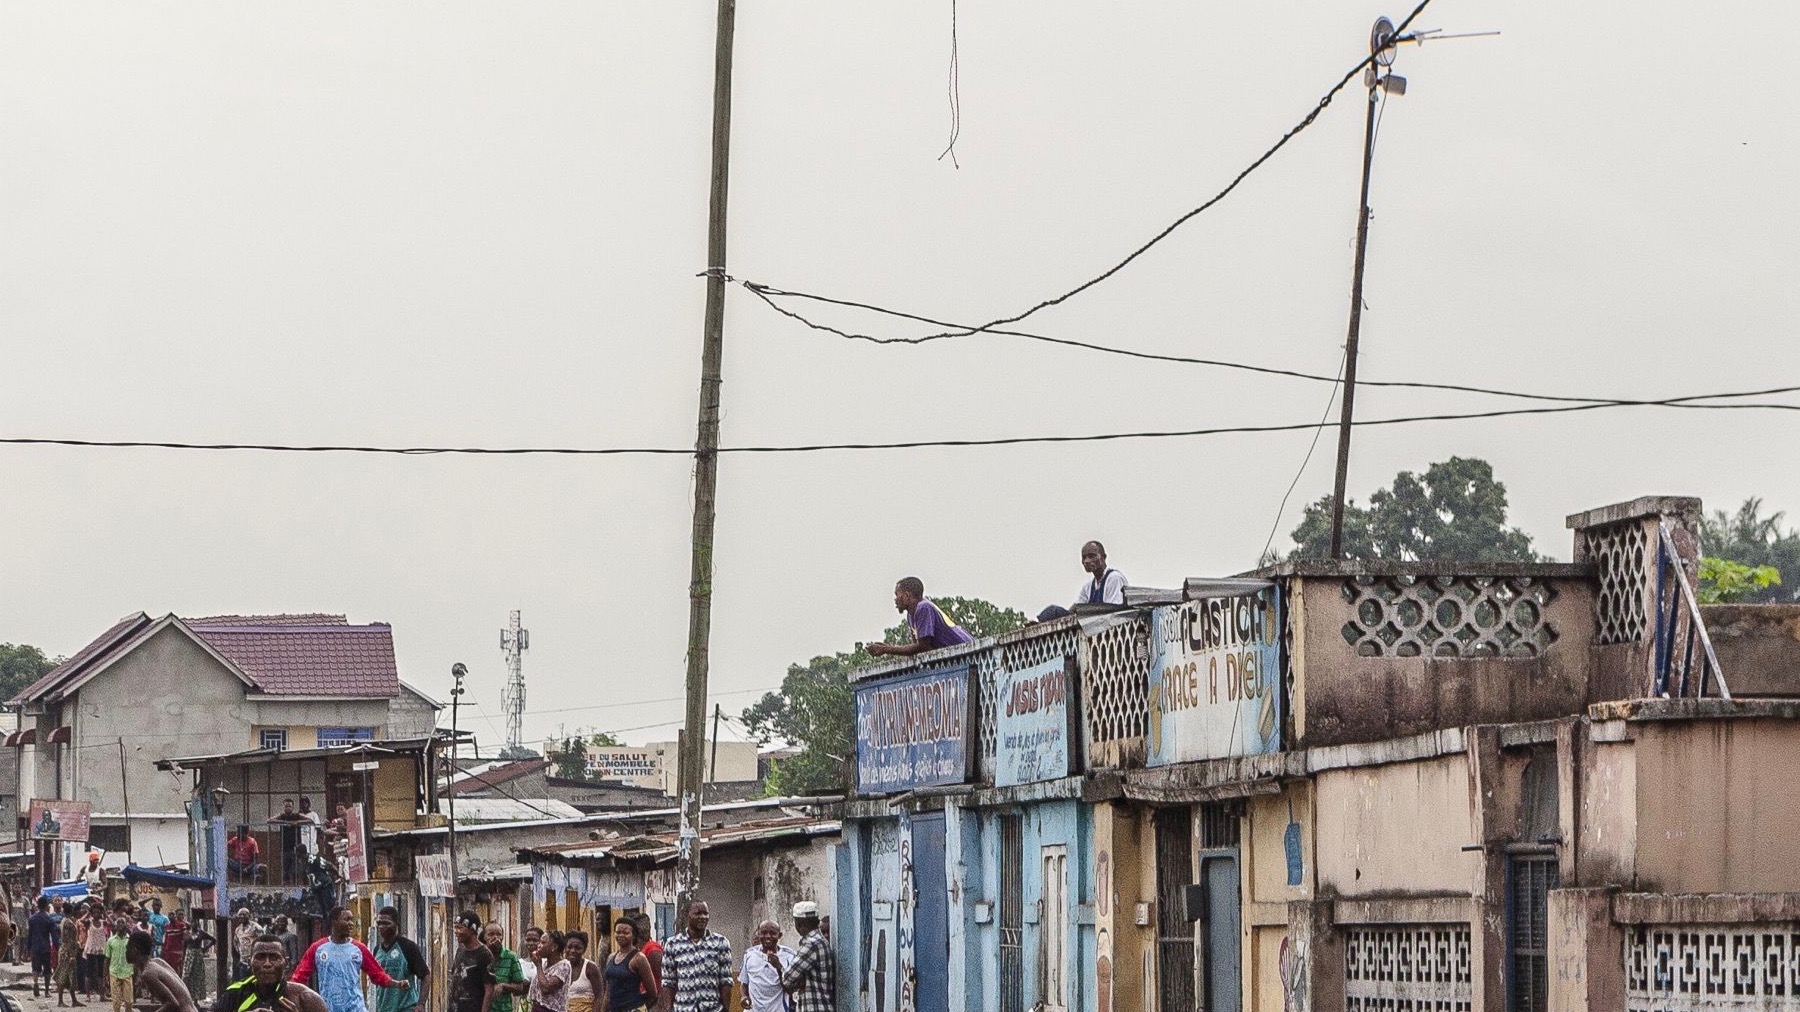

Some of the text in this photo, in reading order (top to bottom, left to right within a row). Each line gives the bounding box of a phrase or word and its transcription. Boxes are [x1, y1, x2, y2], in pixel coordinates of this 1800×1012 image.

[1209, 656, 1218, 705] A
[1226, 649, 1264, 702] DIEU
[600, 753, 610, 761] DU
[612, 753, 648, 761] SALUT
